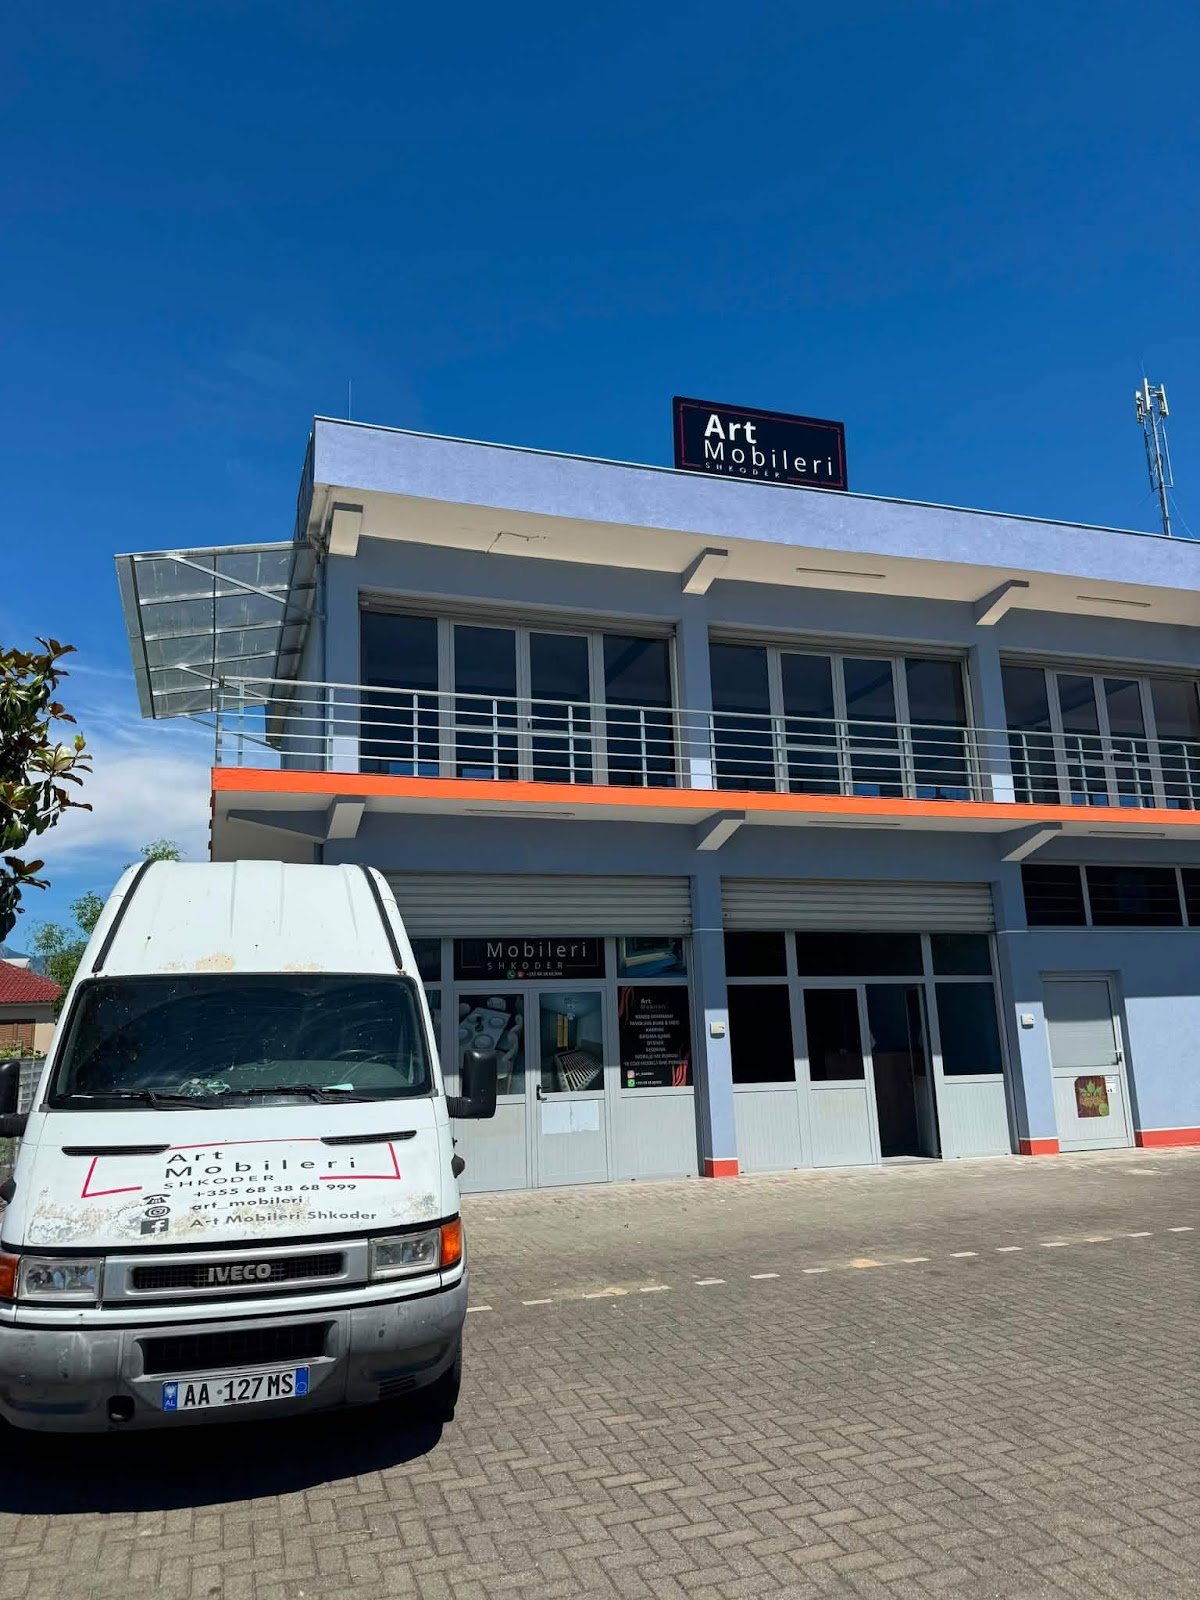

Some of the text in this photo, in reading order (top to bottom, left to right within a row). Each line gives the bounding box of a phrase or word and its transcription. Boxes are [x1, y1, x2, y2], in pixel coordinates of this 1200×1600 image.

[704, 414, 757, 444] Art
[704, 439, 833, 476] Mobileri
[705, 462, 781, 478] SHKODER
[486, 940, 587, 958] Mobileri
[486, 961, 563, 971] SHKODER
[640, 997, 653, 1005] Art
[166, 1151, 224, 1164] Art
[165, 1157, 356, 1179] Mobileri
[163, 1175, 275, 1190] SHKODER
[193, 1183, 357, 1197] +355 68 38 68 999
[191, 1196, 303, 1211] art_mobileri
[225, 1212, 300, 1225] Mobileri
[307, 1210, 377, 1221] Shkoder
[207, 1263, 272, 1282] IVECO
[183, 1373, 293, 1407] AA 127 MS
